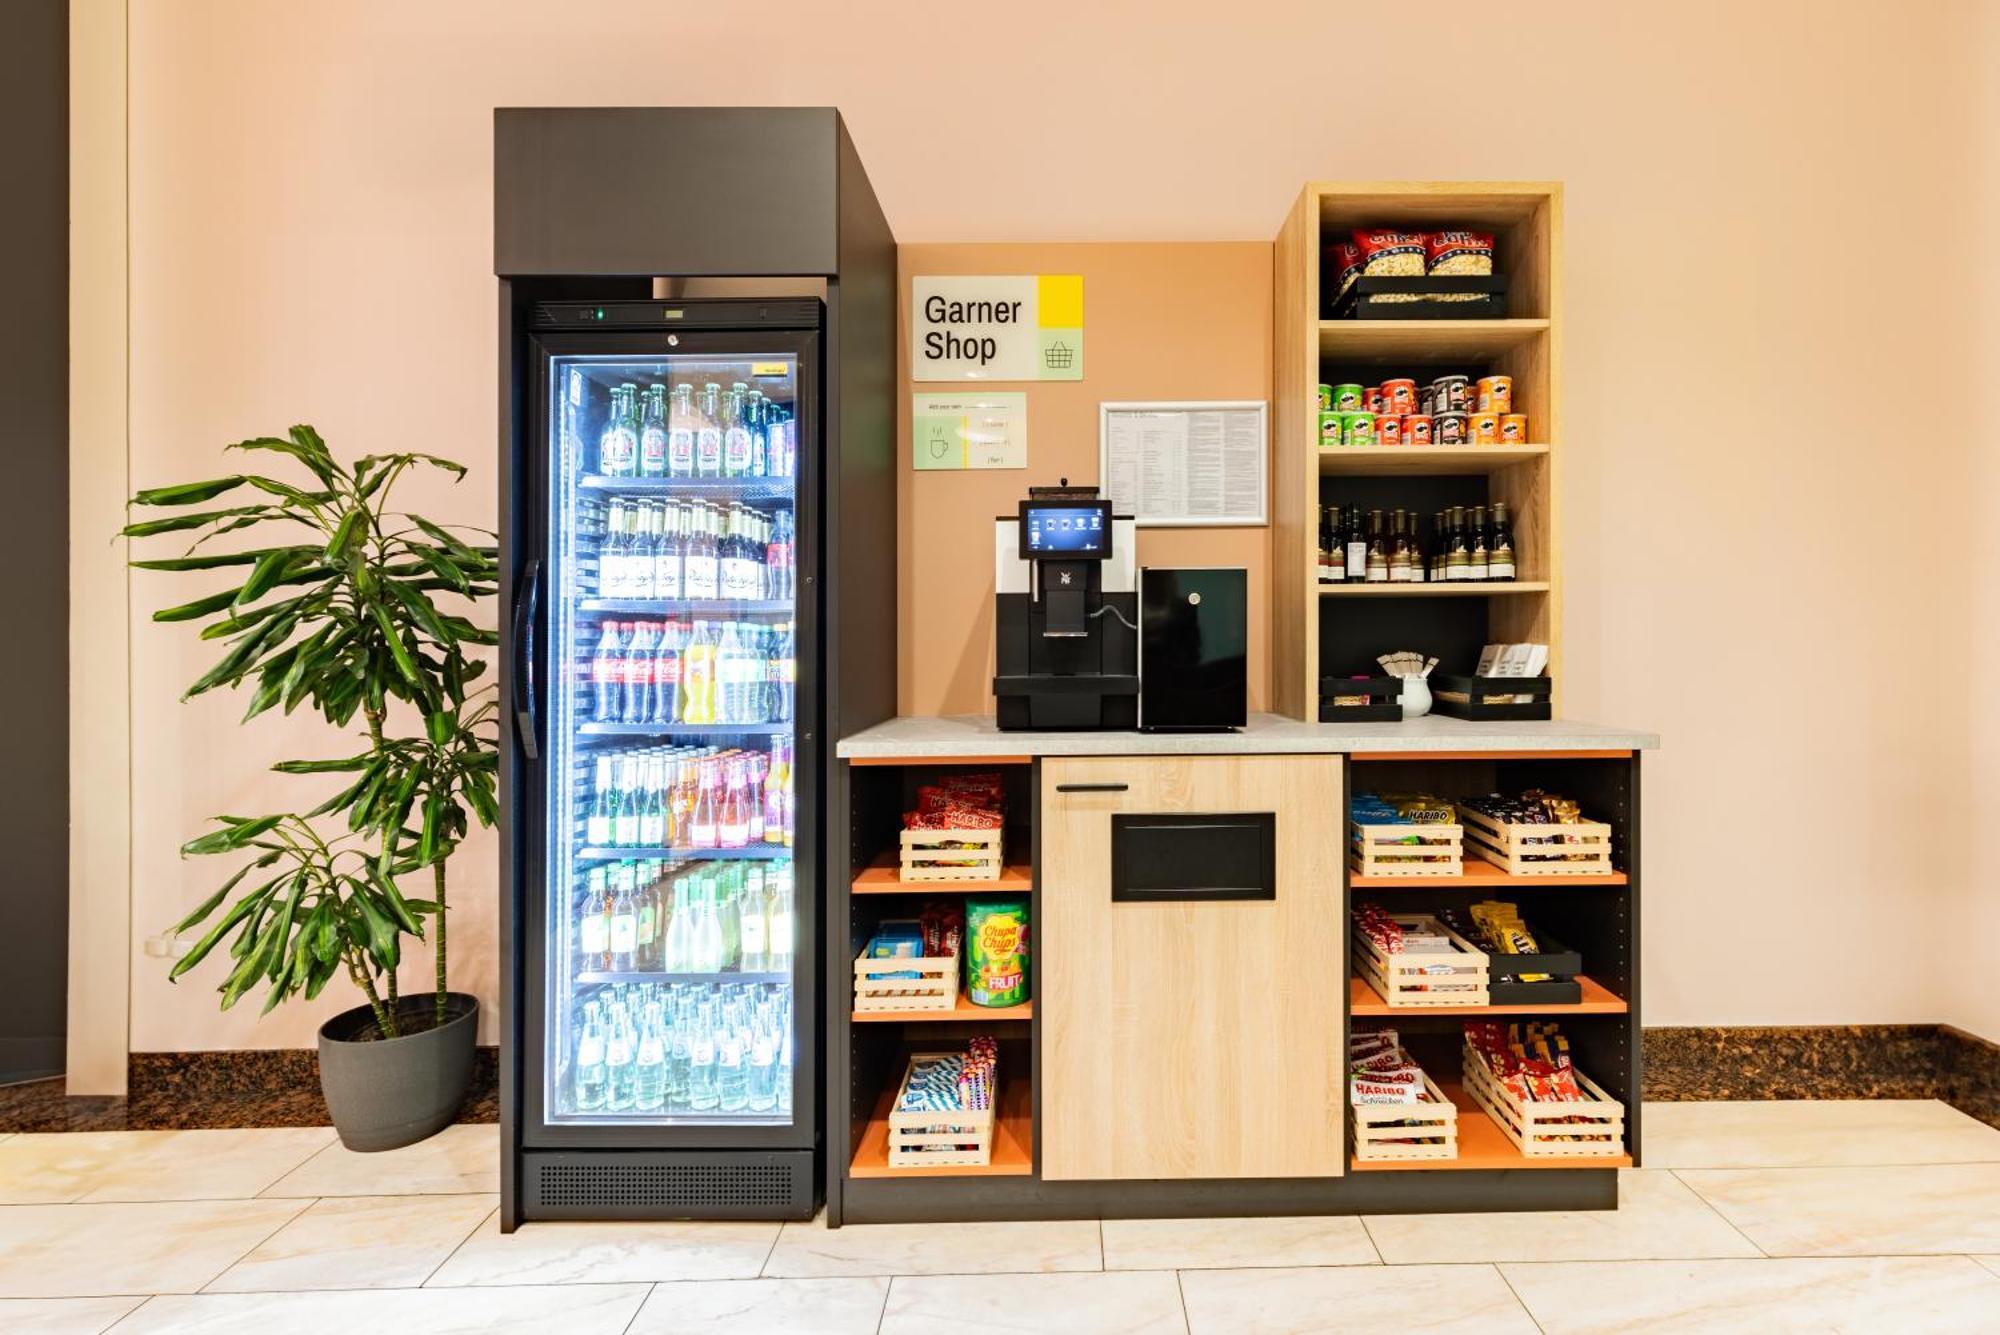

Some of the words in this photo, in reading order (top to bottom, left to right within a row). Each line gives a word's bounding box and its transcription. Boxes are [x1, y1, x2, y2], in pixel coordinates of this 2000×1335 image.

[925, 295, 1022, 323] Garner
[925, 331, 996, 366] Shop
[951, 811, 993, 828] HARIBO
[1408, 809, 1449, 821] HARIBO
[984, 925, 1017, 938] Chupa
[983, 937, 1016, 953] Chups
[989, 974, 1021, 990] FRUIT
[1355, 1083, 1405, 1096] HARIBO
